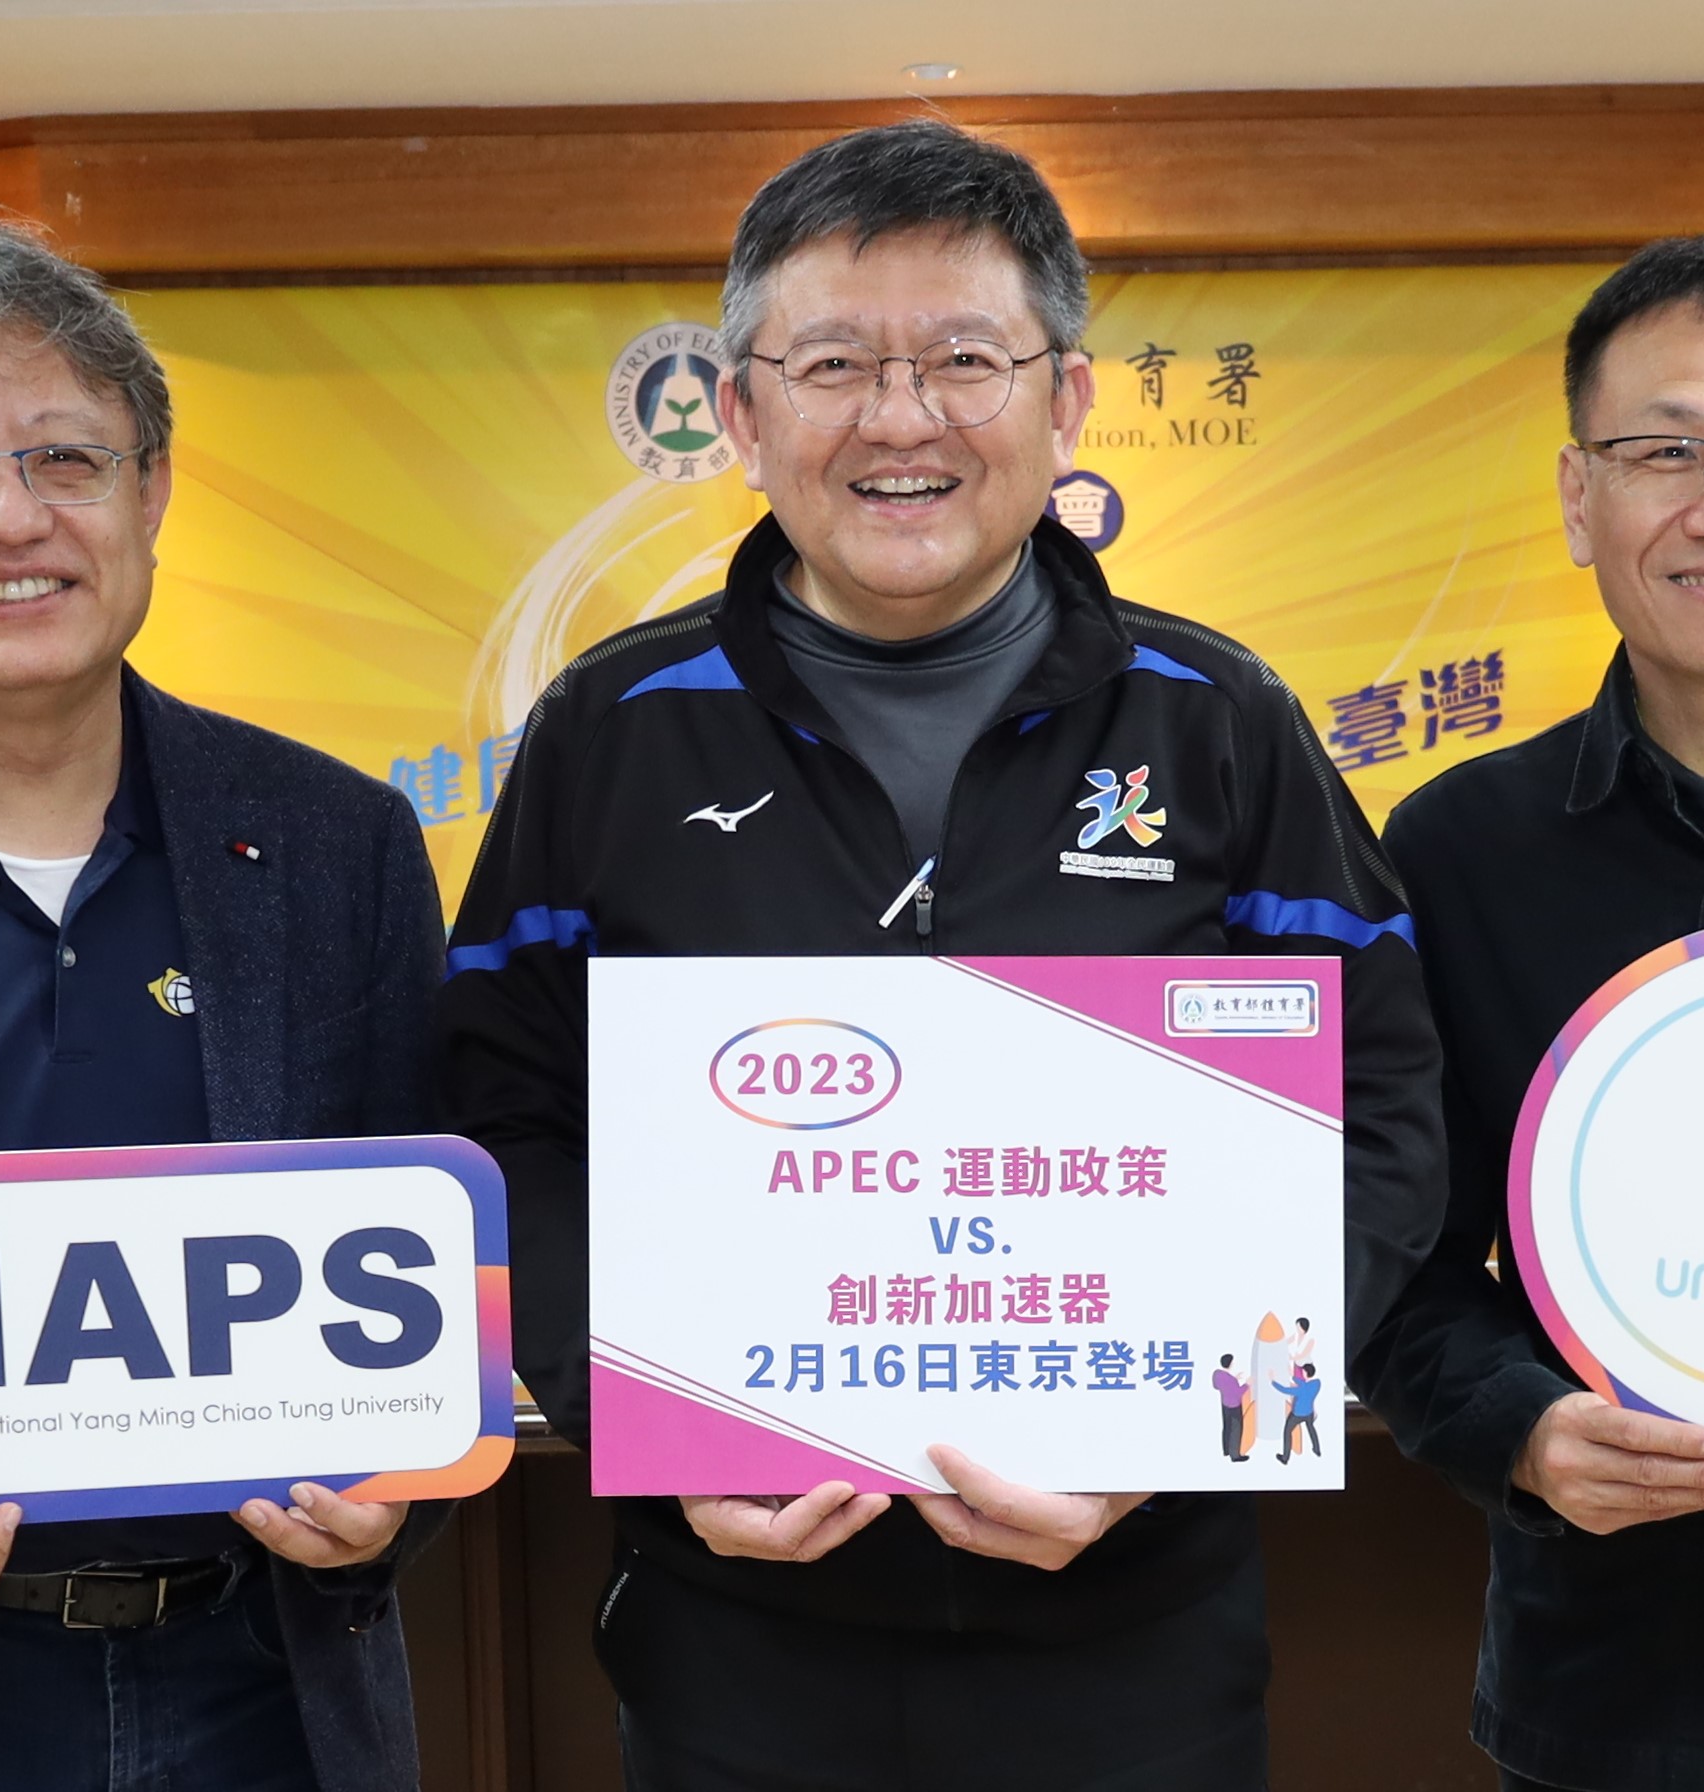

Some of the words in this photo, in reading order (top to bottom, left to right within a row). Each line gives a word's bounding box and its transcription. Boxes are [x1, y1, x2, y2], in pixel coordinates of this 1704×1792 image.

[614, 343, 651, 447] MINISTRY
[656, 332, 685, 351] OF
[1080, 420, 1156, 450] tion,
[1167, 417, 1258, 447] MOE
[638, 445, 731, 480] 教育部
[1050, 479, 1110, 538] 會
[1326, 647, 1504, 772] 臺灣
[737, 1052, 876, 1095] 2023
[767, 1149, 922, 1195] APEC
[942, 1145, 1169, 1198] 運動政策
[928, 1215, 1013, 1256] VS.
[826, 1273, 1112, 1326] 創新加速器
[743, 1339, 1196, 1393] 2月16日東京登場
[69, 1410, 132, 1433] Yang
[137, 1406, 195, 1429] Ming
[202, 1402, 273, 1425] Chiao
[278, 1400, 334, 1422] Tung
[340, 1393, 445, 1417] University
